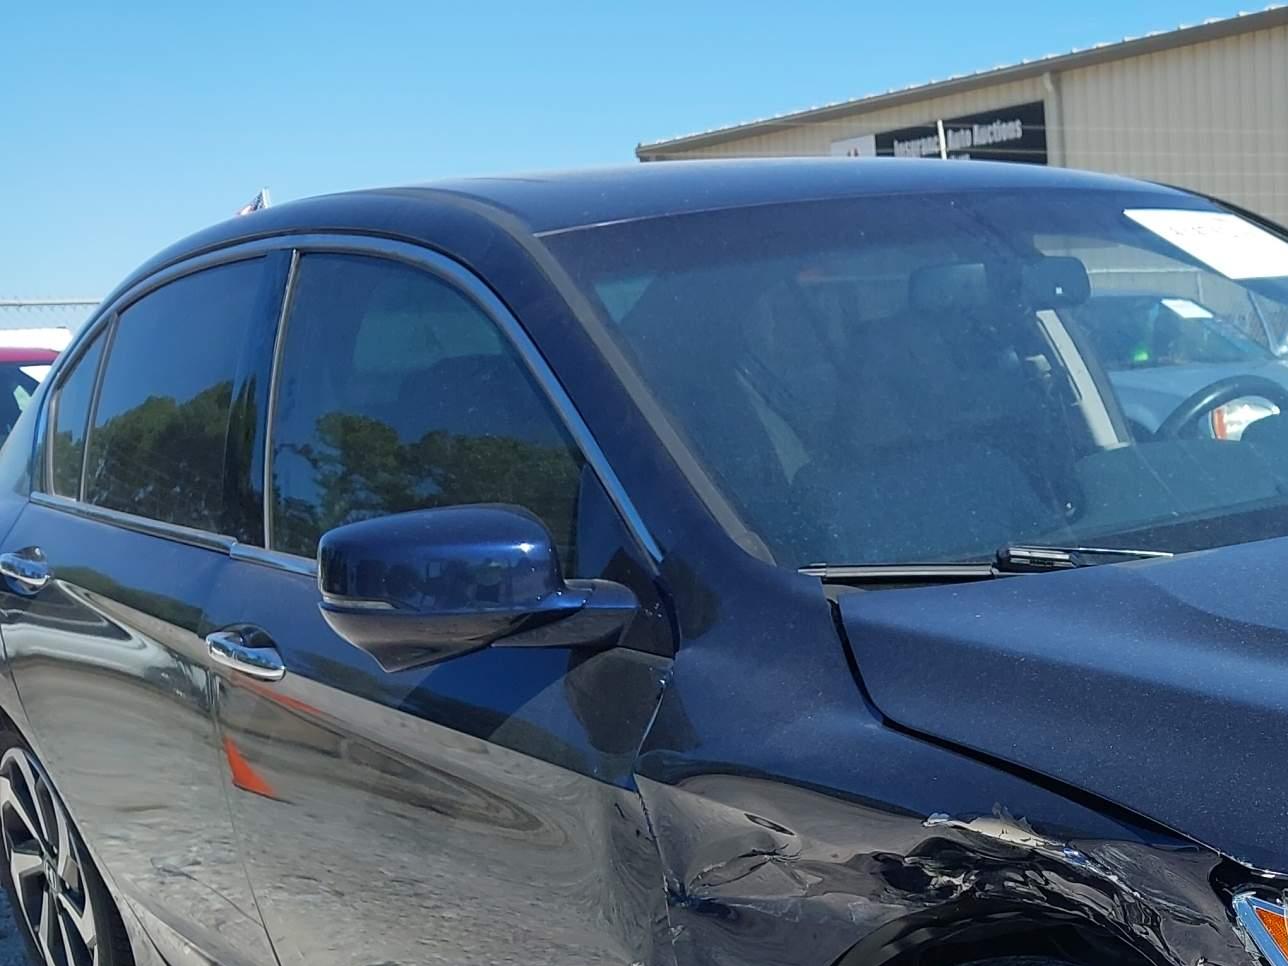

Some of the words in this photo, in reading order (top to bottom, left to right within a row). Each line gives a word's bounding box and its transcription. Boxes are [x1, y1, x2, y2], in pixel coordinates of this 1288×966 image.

[893, 135, 940, 158] Insuranc
[946, 128, 972, 151] Auto
[973, 119, 1023, 146] Auctions
